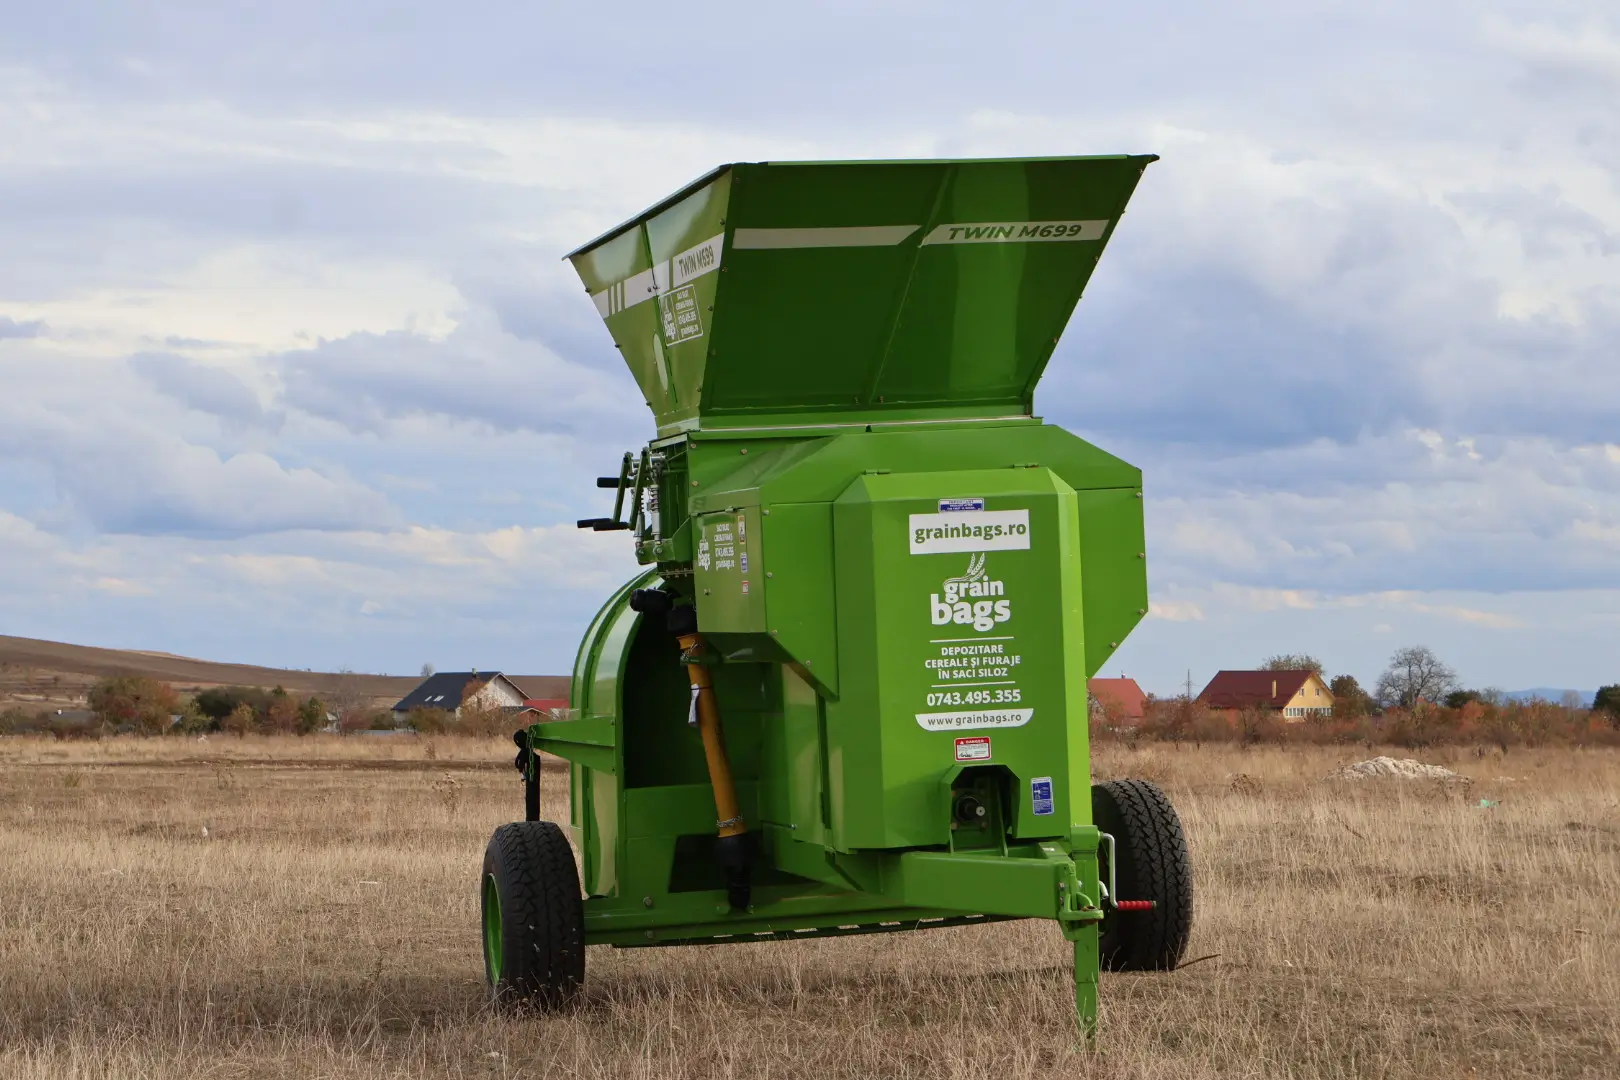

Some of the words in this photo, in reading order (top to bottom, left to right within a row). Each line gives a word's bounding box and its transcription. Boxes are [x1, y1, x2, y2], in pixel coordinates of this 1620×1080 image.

[949, 226, 1015, 240] TWIN
[1018, 224, 1082, 238] M699
[679, 249, 698, 278] TWIN
[915, 523, 1026, 543] grainbags.ro
[943, 575, 1004, 604] grain
[930, 593, 1011, 632] bags
[941, 644, 1004, 656] DEPOZITARE
[924, 658, 968, 669] CEREALE
[982, 655, 1021, 666] FURAJE
[952, 669, 976, 679] SACI
[978, 667, 1008, 678] SILOZ
[926, 689, 1021, 707] 0743.495.355
